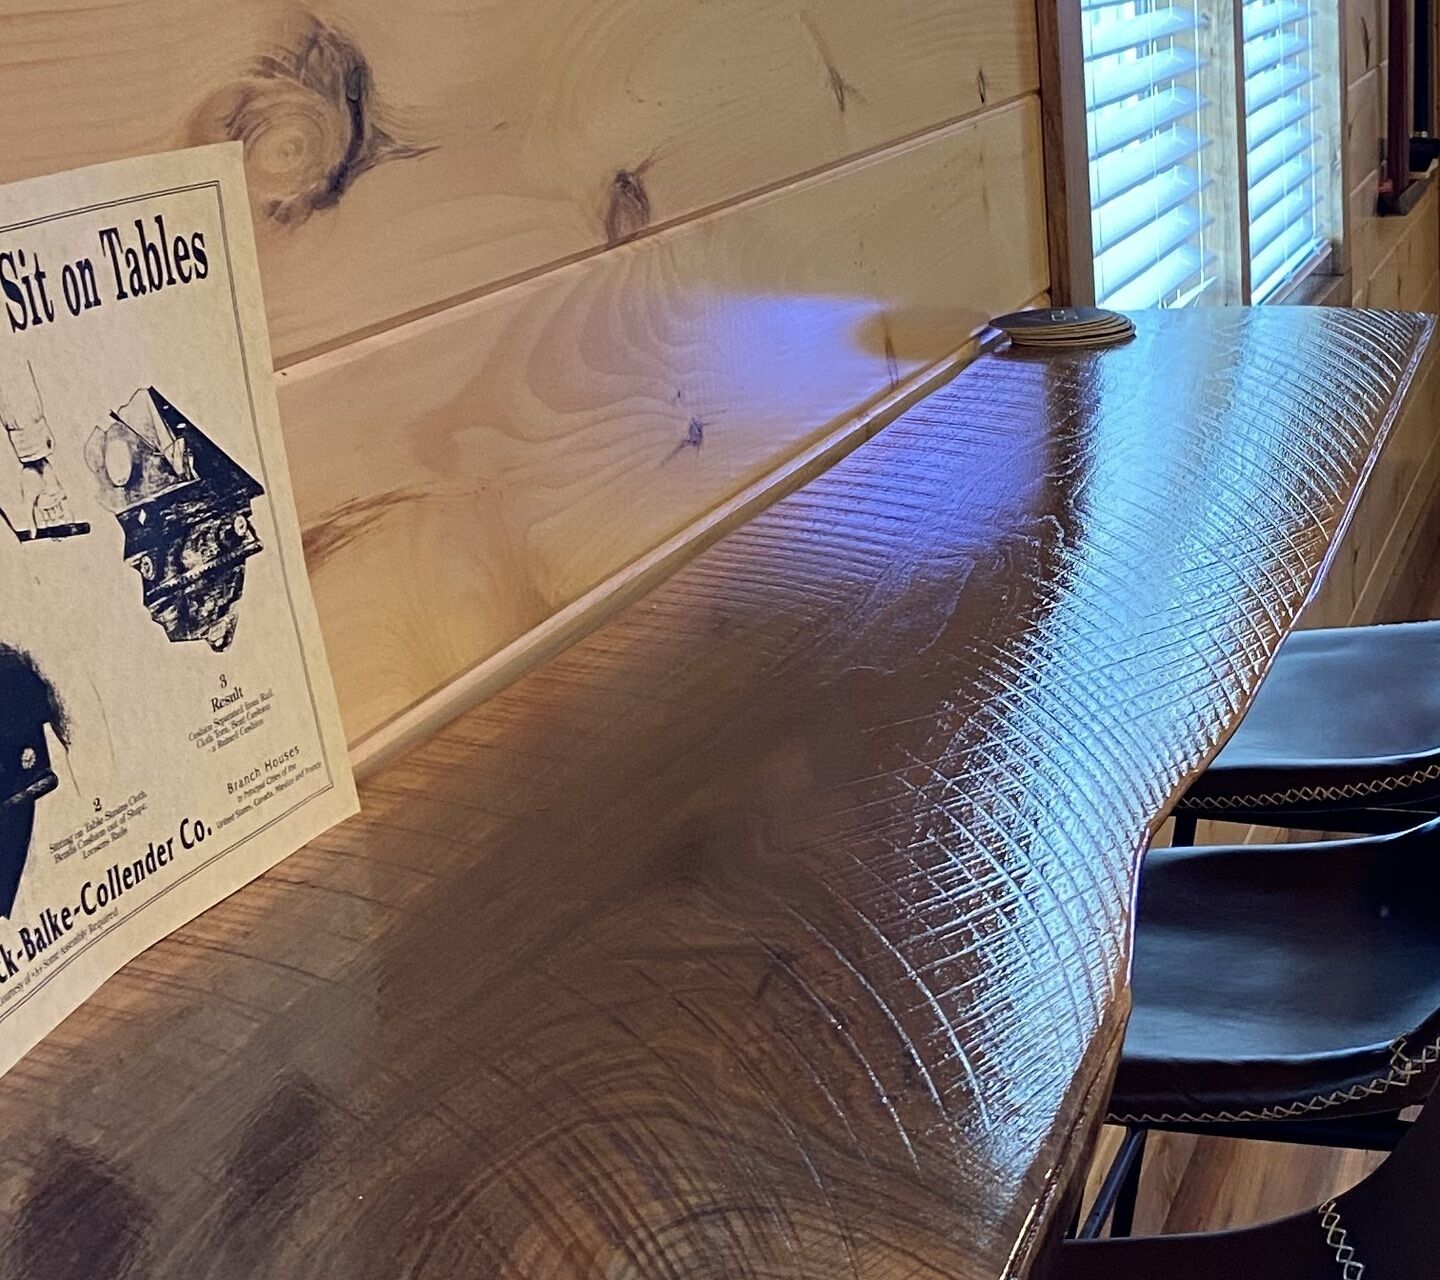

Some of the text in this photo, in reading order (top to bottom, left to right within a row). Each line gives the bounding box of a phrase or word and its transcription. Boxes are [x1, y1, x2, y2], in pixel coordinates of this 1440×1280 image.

[0, 215, 209, 333] Sit on Tables
[219, 673, 228, 689] 3
[210, 686, 244, 713] Result
[227, 745, 300, 795] Branch Houses
[93, 797, 102, 812] 2
[85, 816, 104, 833] Table
[180, 818, 212, 850] Co.
